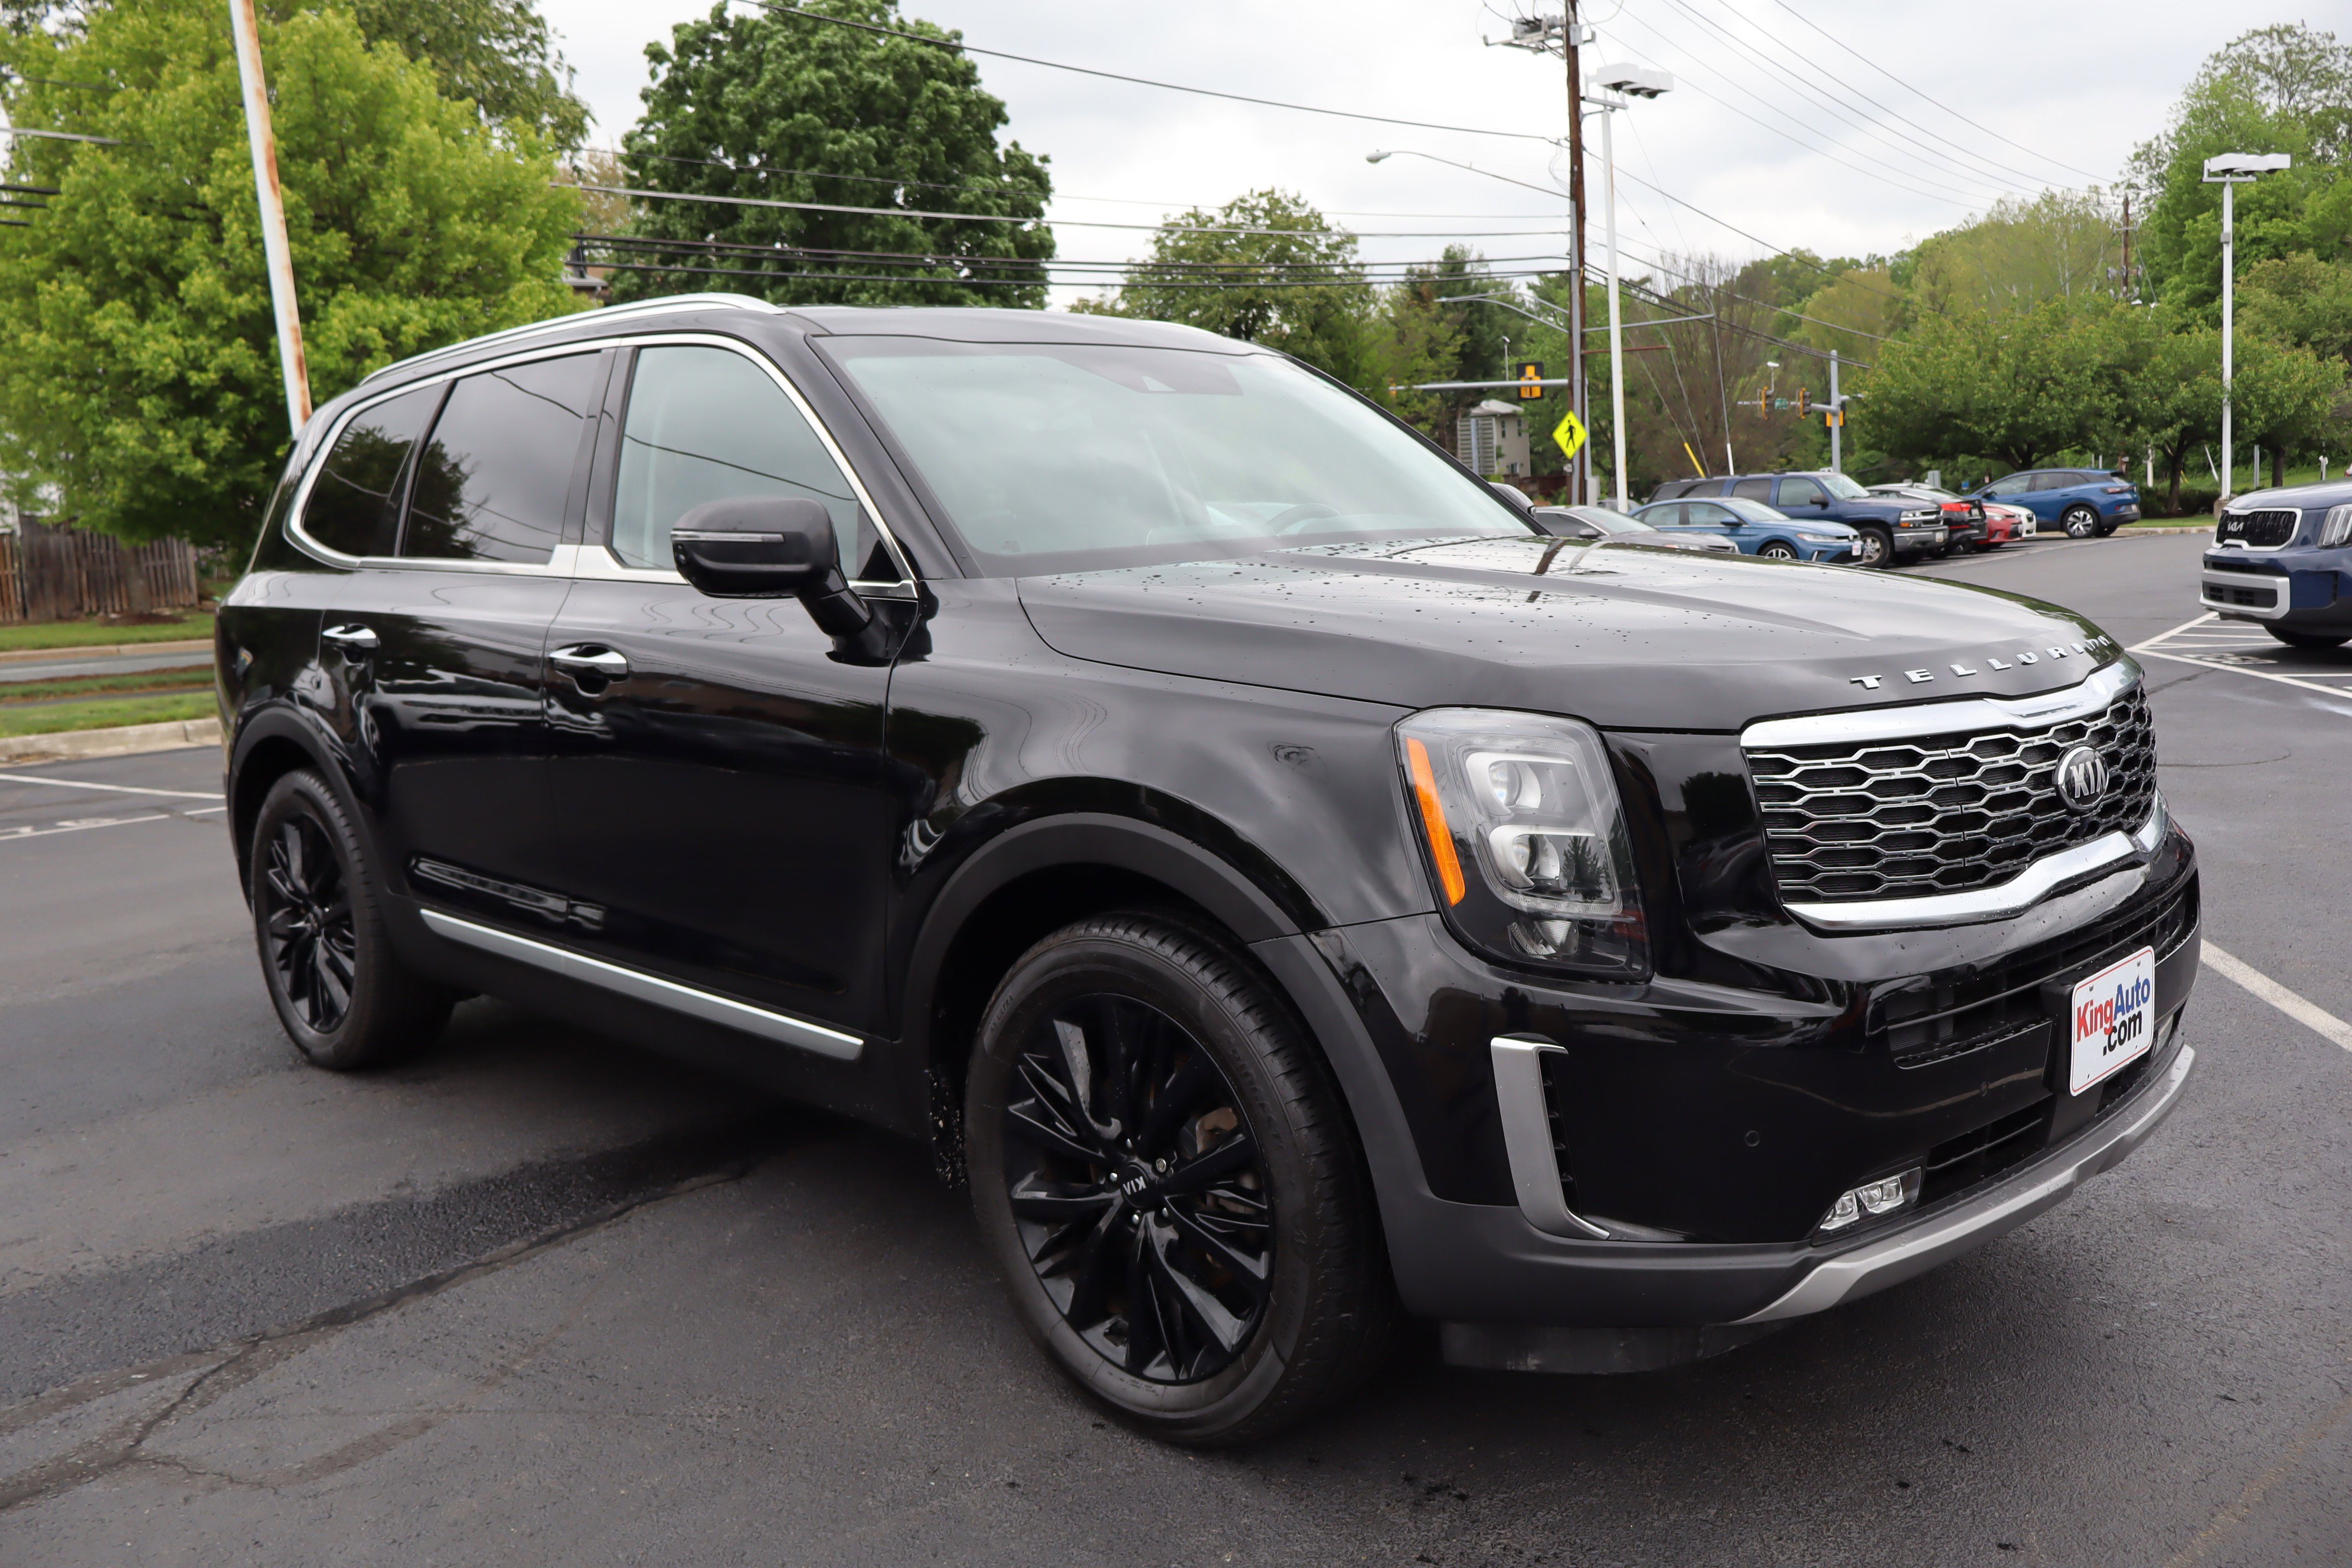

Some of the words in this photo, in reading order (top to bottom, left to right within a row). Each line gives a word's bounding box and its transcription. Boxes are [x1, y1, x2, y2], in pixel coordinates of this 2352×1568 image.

[2069, 758, 2107, 798] KIA
[2076, 975, 2151, 1043] KingAuto
[2102, 1010, 2142, 1057] .com
[1122, 1175, 1146, 1195] KIA
